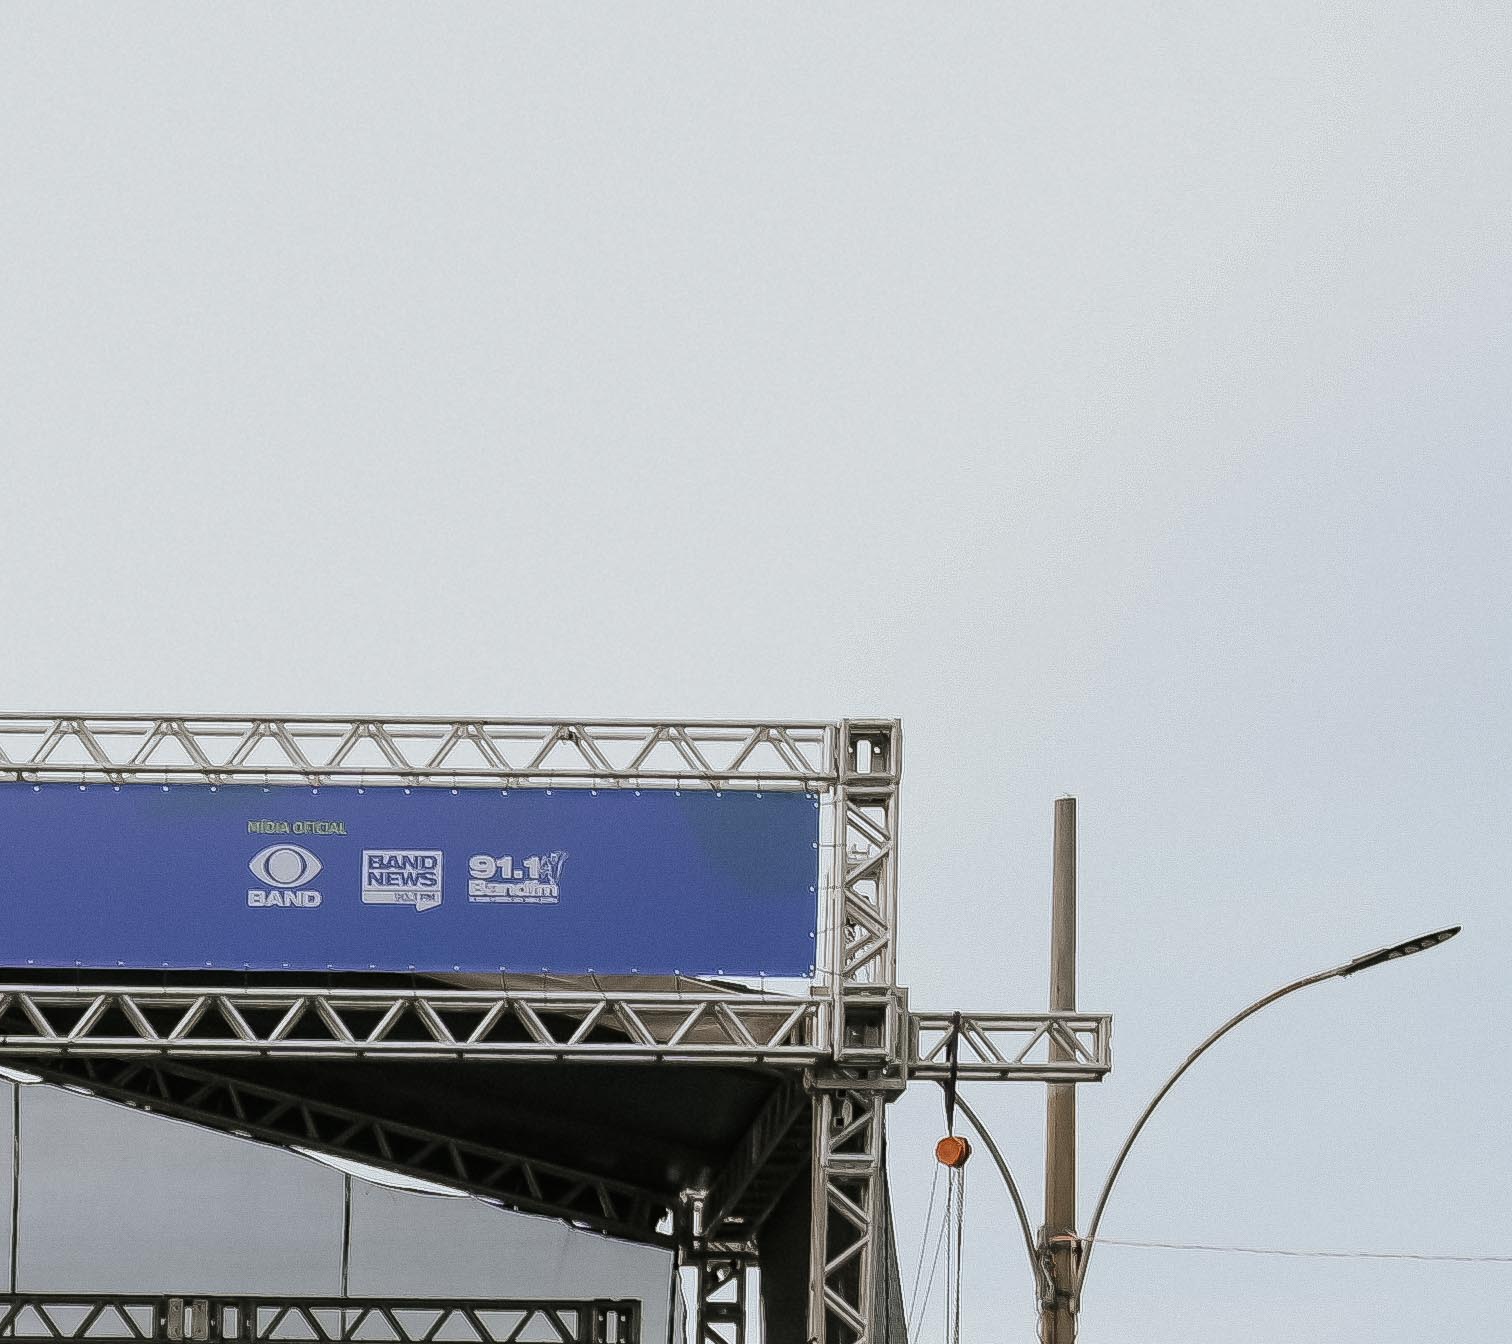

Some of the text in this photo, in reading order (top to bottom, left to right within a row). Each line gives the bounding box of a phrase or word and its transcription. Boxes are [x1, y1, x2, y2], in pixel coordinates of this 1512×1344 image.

[368, 855, 438, 870] BAND
[469, 854, 541, 880] 91.1
[367, 872, 438, 887] NEWS
[248, 890, 322, 907] BAND
